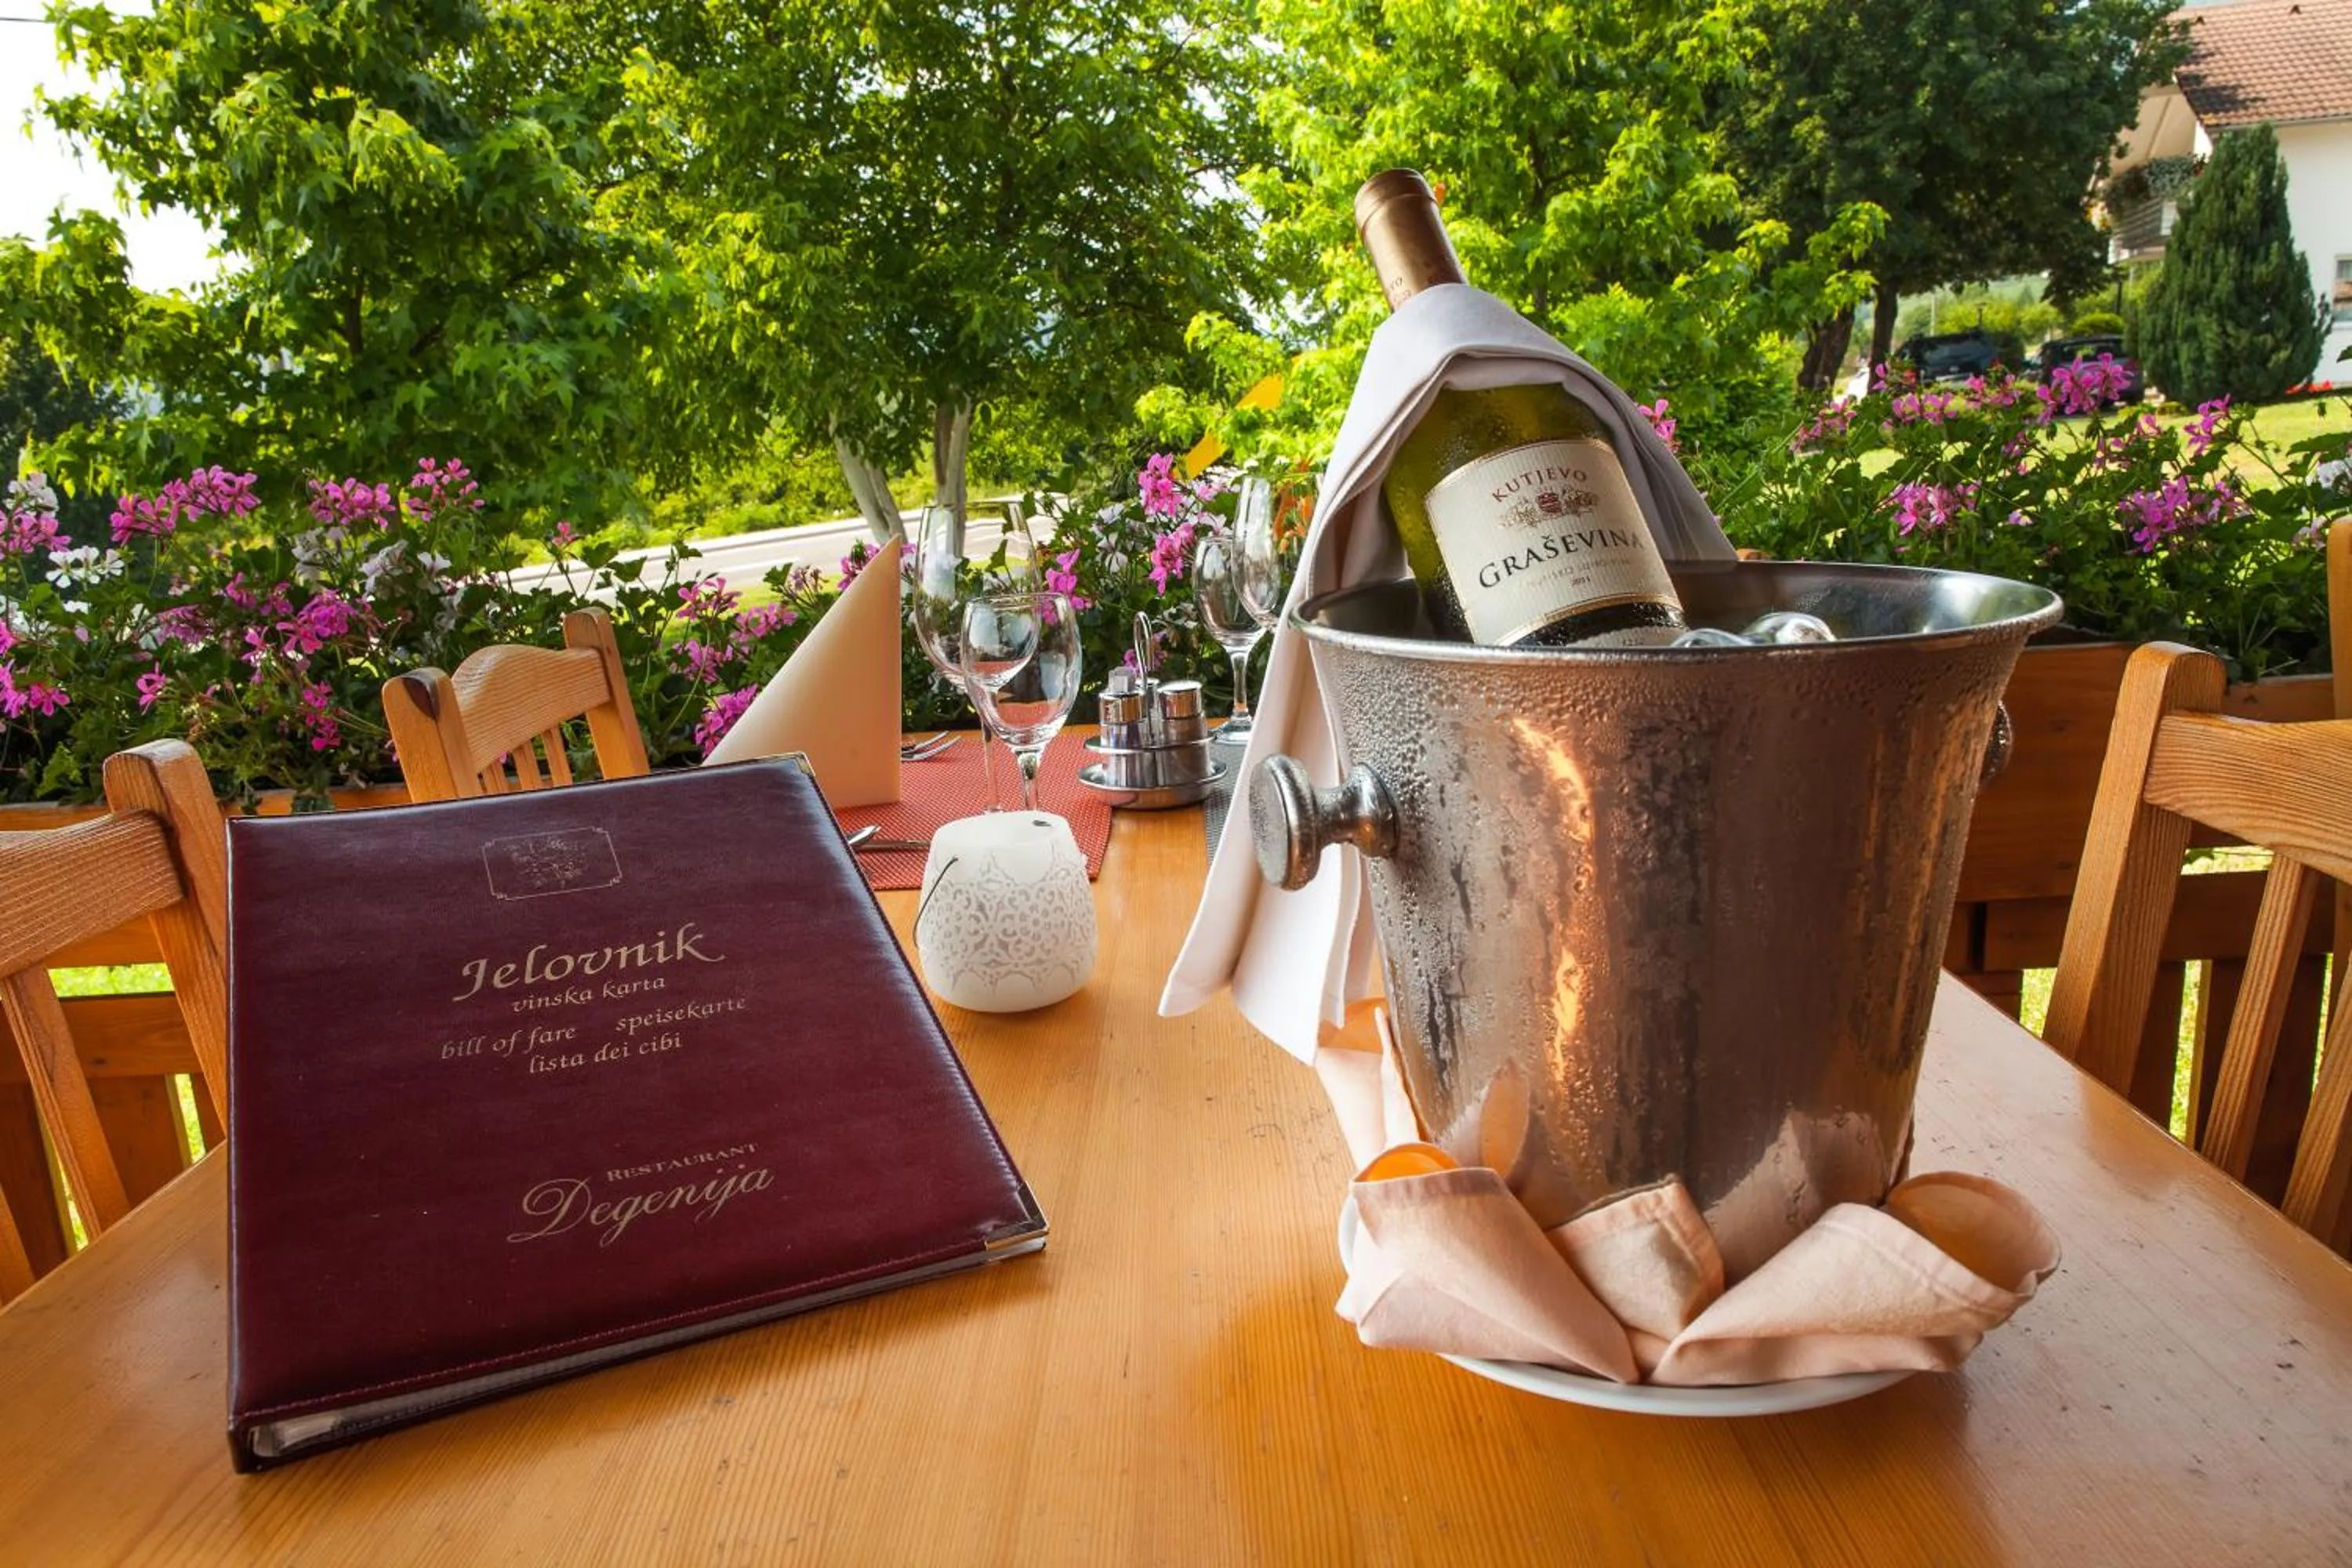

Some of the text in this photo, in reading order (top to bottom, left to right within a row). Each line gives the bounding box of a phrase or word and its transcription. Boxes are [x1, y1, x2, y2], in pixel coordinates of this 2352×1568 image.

[1492, 467, 1588, 503] KUTJEVO
[1479, 528, 1644, 588] GRAŠEVINA
[452, 922, 726, 1002] Jelovnik
[513, 976, 666, 1013] vinska karta
[615, 996, 747, 1035] speisekarte
[441, 1025, 577, 1060] bill of fare
[528, 1032, 683, 1074] lista dei cibi
[606, 1142, 759, 1182] RESTAURANT
[506, 1163, 775, 1248] Degenija
